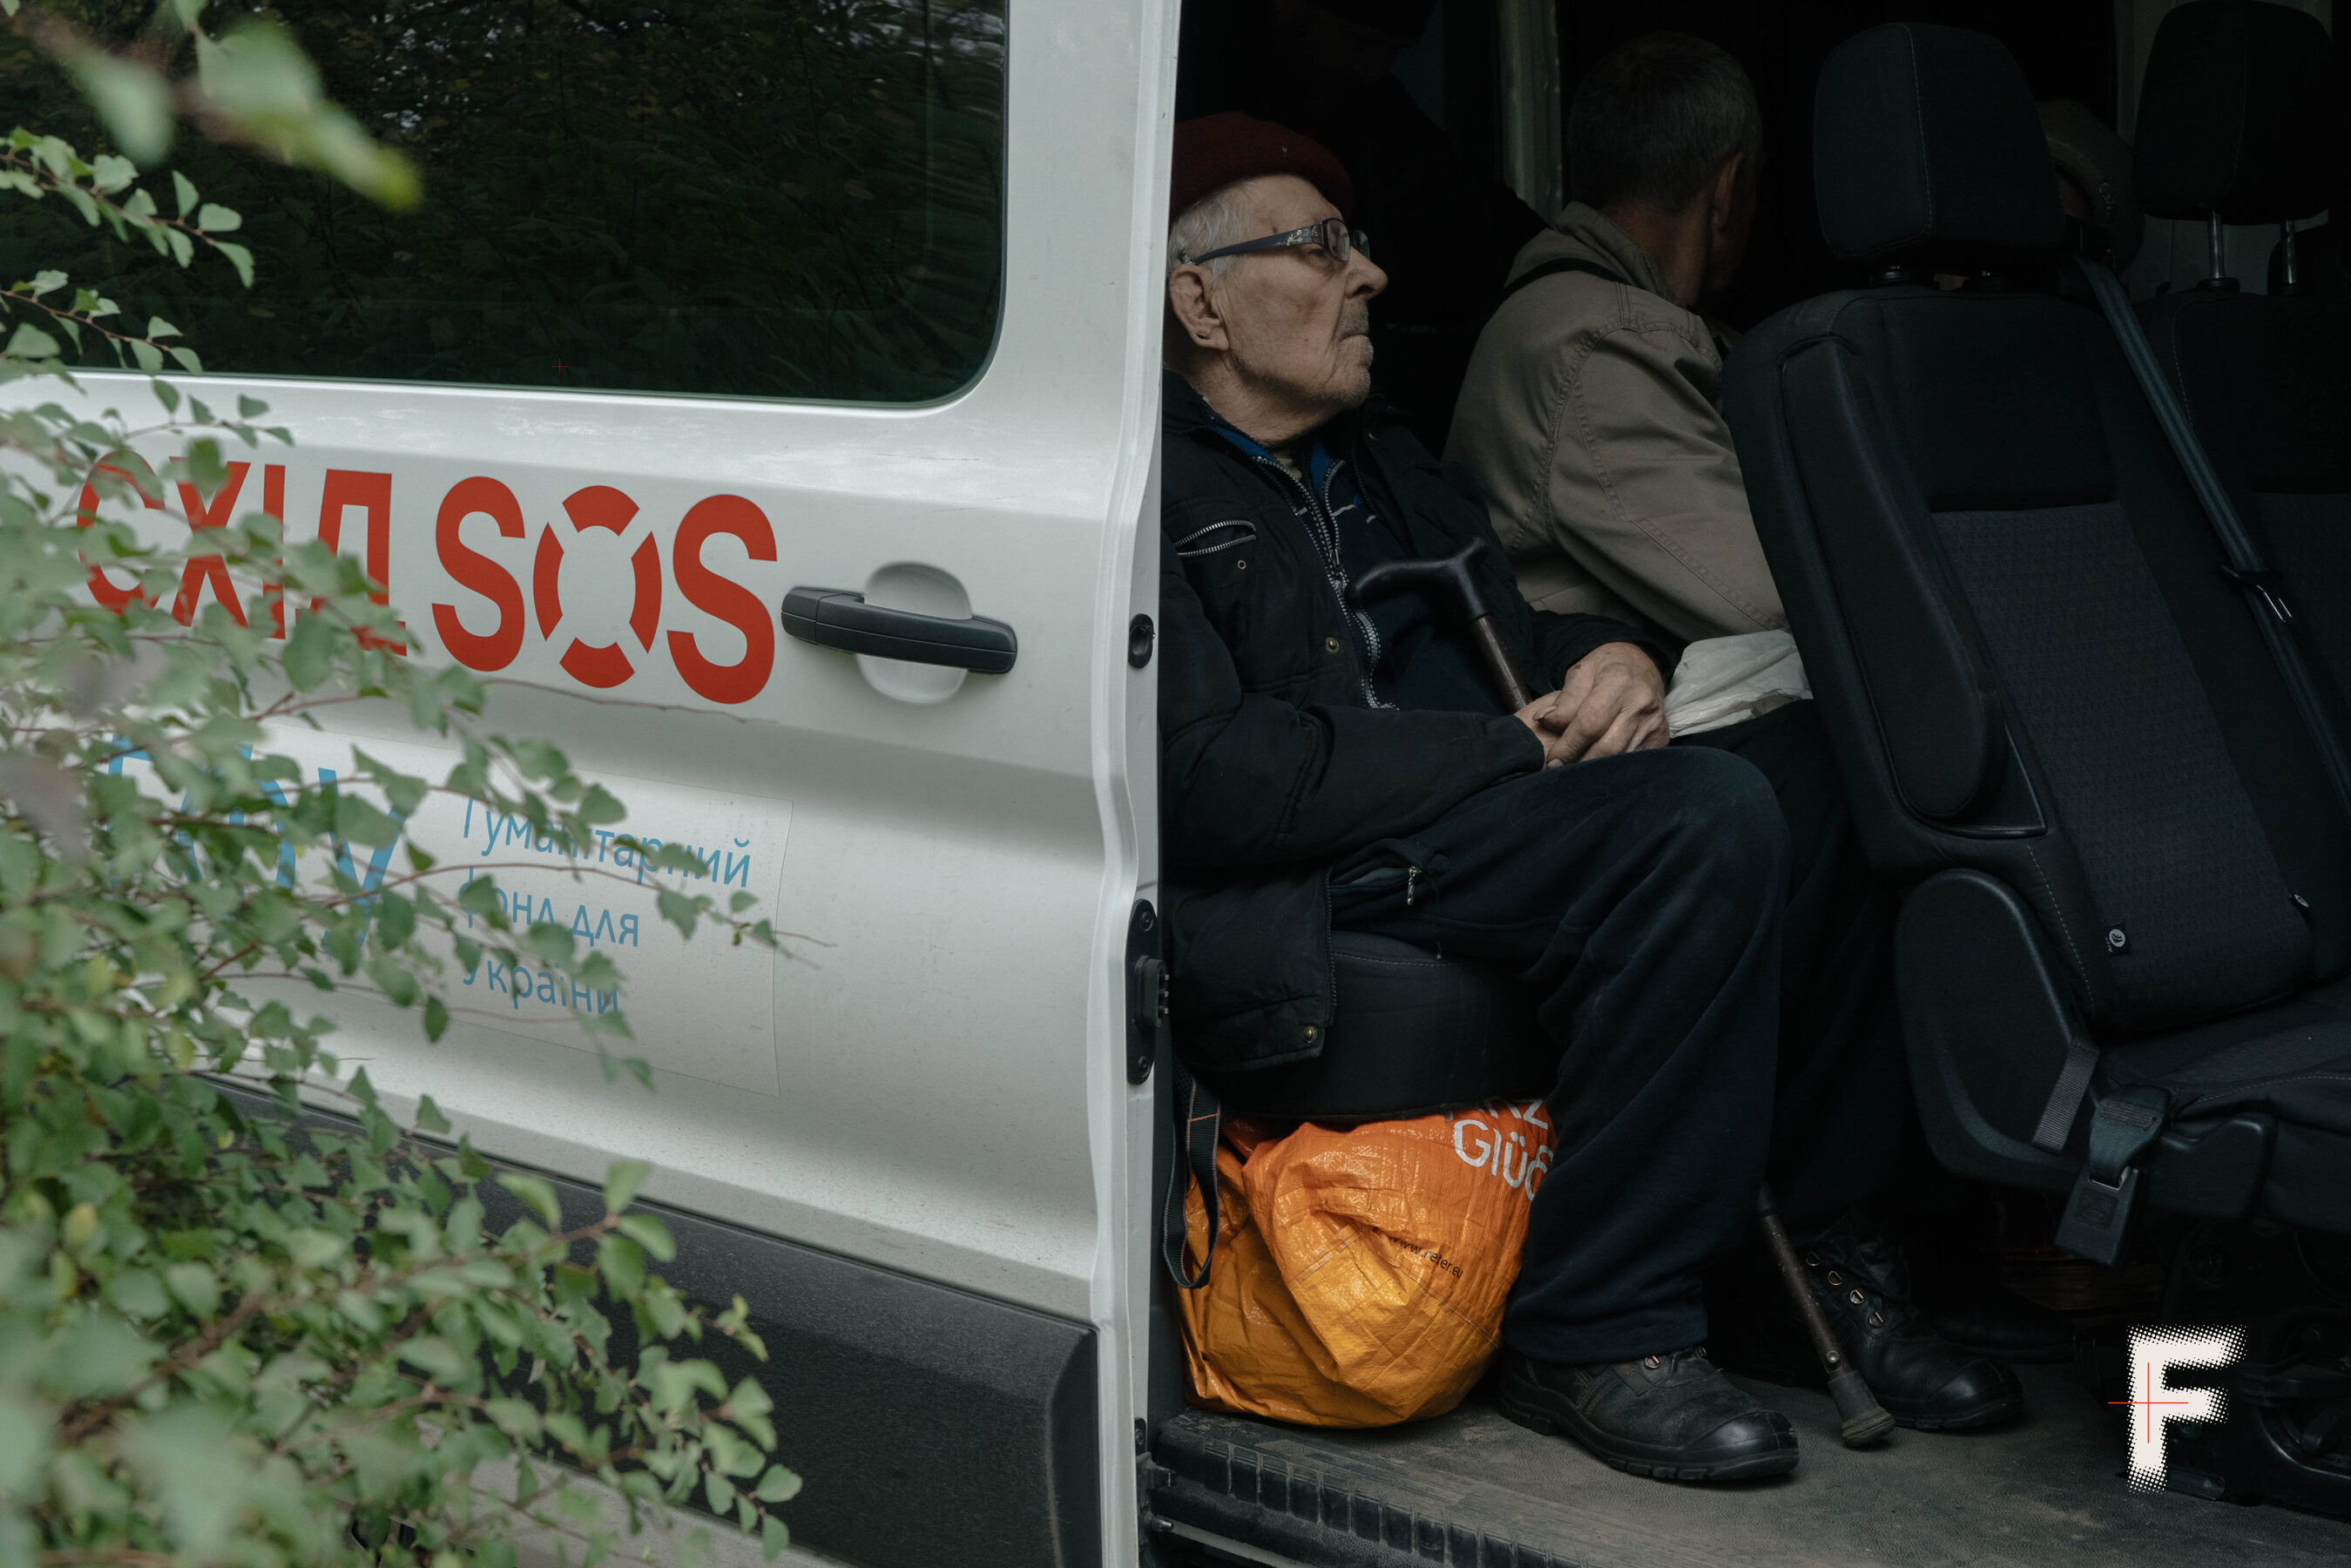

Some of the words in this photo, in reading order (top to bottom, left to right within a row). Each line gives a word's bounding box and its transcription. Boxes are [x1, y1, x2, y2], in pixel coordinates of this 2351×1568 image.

[432, 476, 778, 704] SOS
[463, 796, 751, 888] Гумантарий
[571, 903, 639, 948] для
[463, 958, 619, 1016] країни
